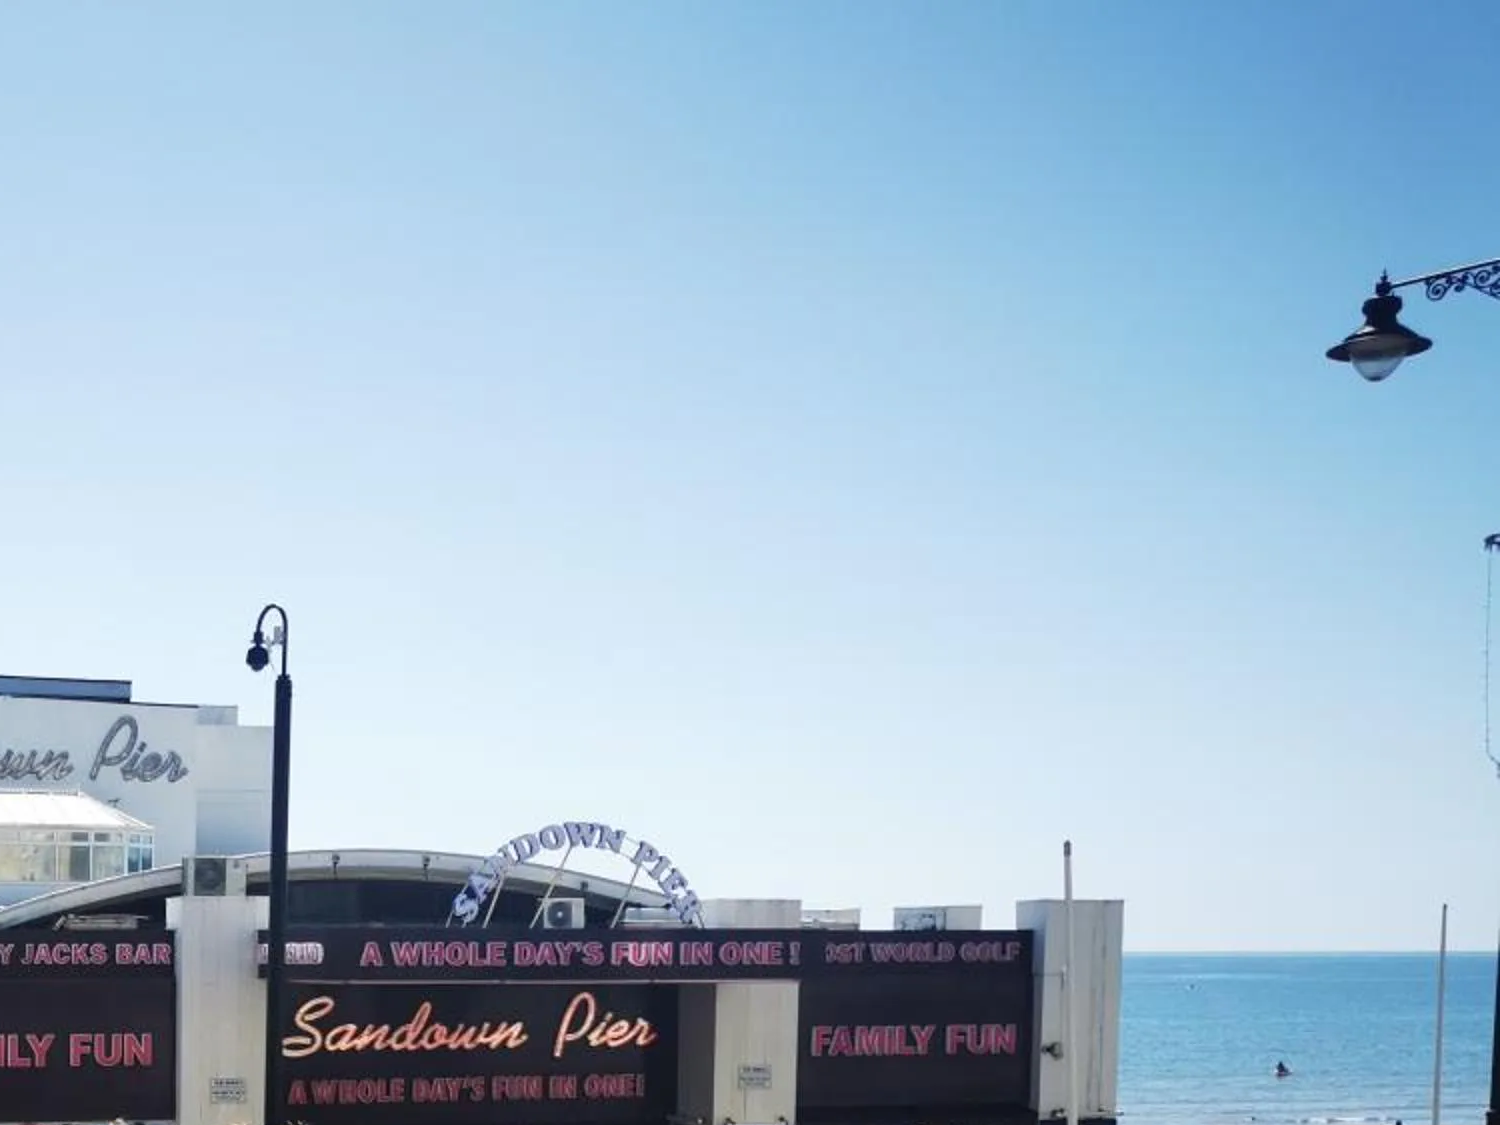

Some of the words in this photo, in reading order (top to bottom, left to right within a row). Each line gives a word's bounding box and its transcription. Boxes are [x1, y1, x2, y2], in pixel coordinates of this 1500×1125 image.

[89, 714, 189, 783] Pier
[452, 821, 627, 924] SANDOWN
[631, 840, 702, 925] PIER
[20, 943, 108, 966] JACKS
[115, 943, 172, 965] BAR
[360, 941, 383, 967] A
[390, 942, 506, 967] WHOLE
[513, 942, 604, 967] DAY'S
[610, 941, 673, 967] FUN
[679, 941, 713, 965] IN
[869, 941, 956, 964] WORLD
[959, 941, 1021, 963] GOLF
[281, 995, 529, 1058] Sandown
[553, 991, 658, 1058] Pier
[811, 1025, 936, 1057] FAMILY
[945, 1024, 1017, 1056] FUN
[69, 1032, 153, 1068] FUN
[287, 1078, 308, 1105] A
[312, 1078, 405, 1105] WHOLE
[411, 1076, 485, 1102] DAY'S
[491, 1075, 542, 1100] FUN
[548, 1075, 576, 1099] IN
